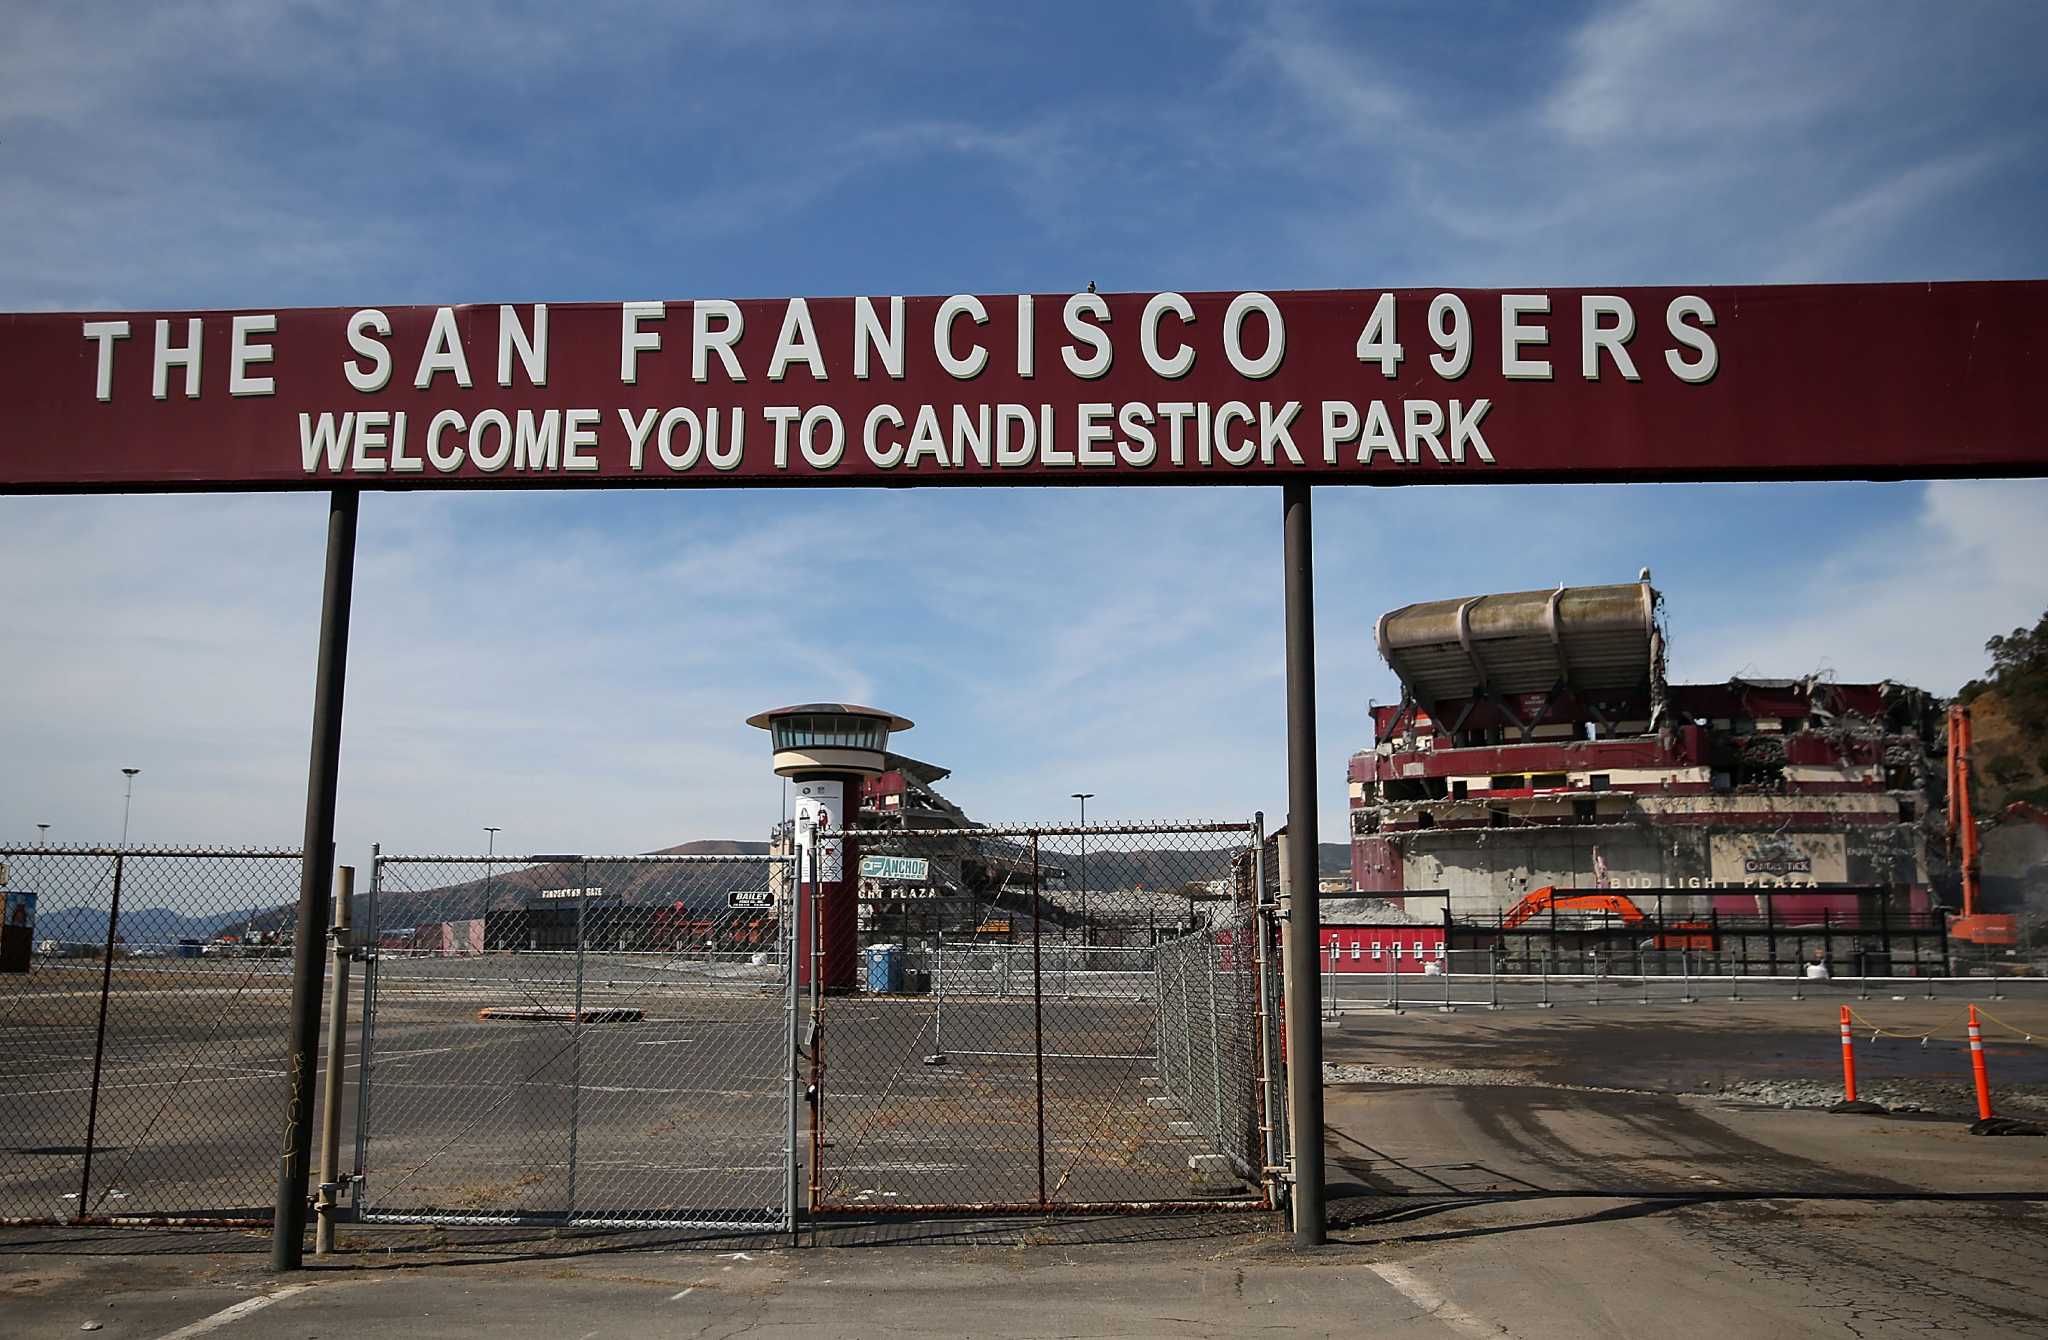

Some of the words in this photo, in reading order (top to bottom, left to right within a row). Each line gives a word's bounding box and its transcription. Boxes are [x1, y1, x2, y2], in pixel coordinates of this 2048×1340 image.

[82, 314, 277, 402] THE
[343, 304, 549, 393] SAN
[620, 292, 1286, 385] FRANCISCO
[1356, 291, 1719, 384] 49ERS
[299, 408, 601, 473] WELCOME
[617, 406, 745, 471] YOU
[763, 404, 845, 470] TO
[863, 400, 1305, 469] CANDLESTICK
[1321, 398, 1496, 465] PARK
[883, 858, 926, 876] ANCHOR
[1610, 878, 1652, 889] BUD
[1665, 878, 1729, 888] LIGHT
[1743, 877, 1818, 888] PLAZA
[858, 889, 884, 899] GHT
[891, 887, 937, 899] PLAZA
